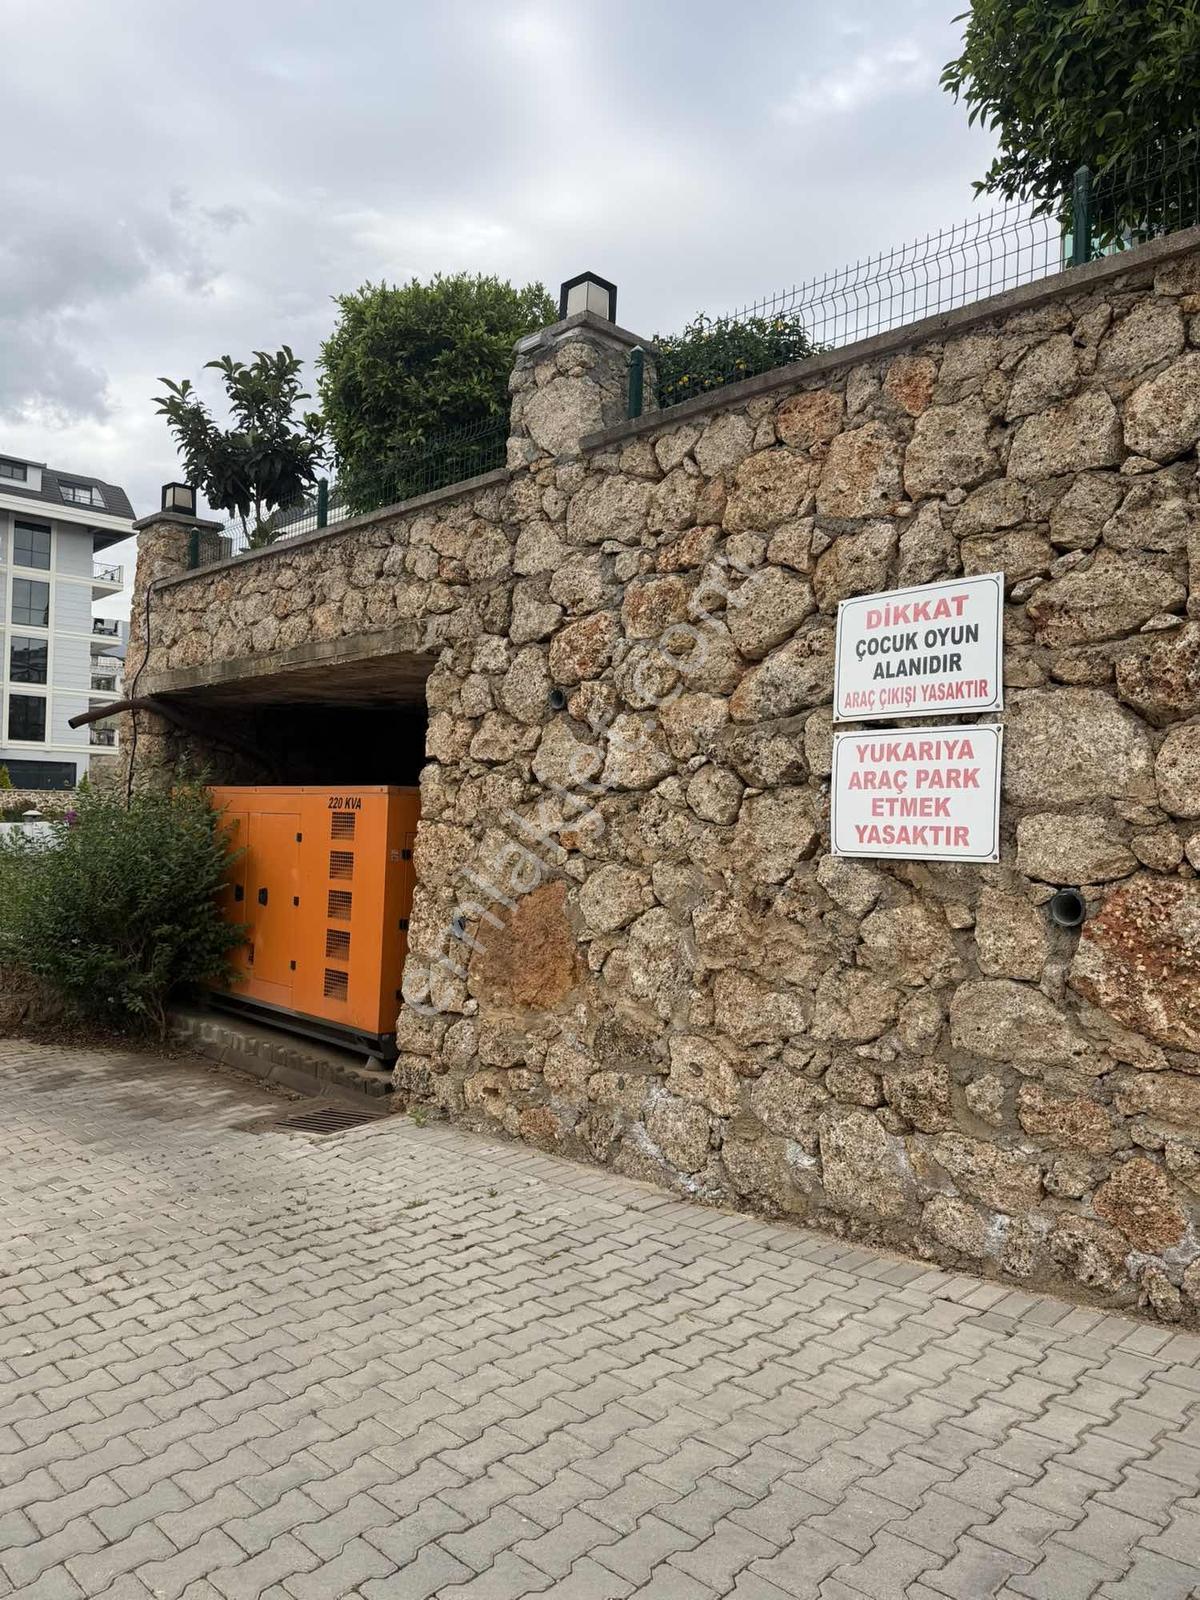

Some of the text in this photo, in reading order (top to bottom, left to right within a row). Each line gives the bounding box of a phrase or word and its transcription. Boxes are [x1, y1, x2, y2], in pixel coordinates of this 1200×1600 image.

[866, 595, 969, 629] DİKKAT
[855, 624, 979, 661] ÇOCUK OYUN
[872, 653, 962, 680] ALANIDIR
[844, 679, 988, 711] ARAÇ ÇIKIŞI YASAKTIR
[856, 740, 974, 763] YUKARIYA
[848, 768, 981, 794] ARAÇ PARK
[328, 797, 362, 809] 220 KVA
[871, 797, 951, 817] ETMEK
[855, 825, 970, 846] YASAKTIR
